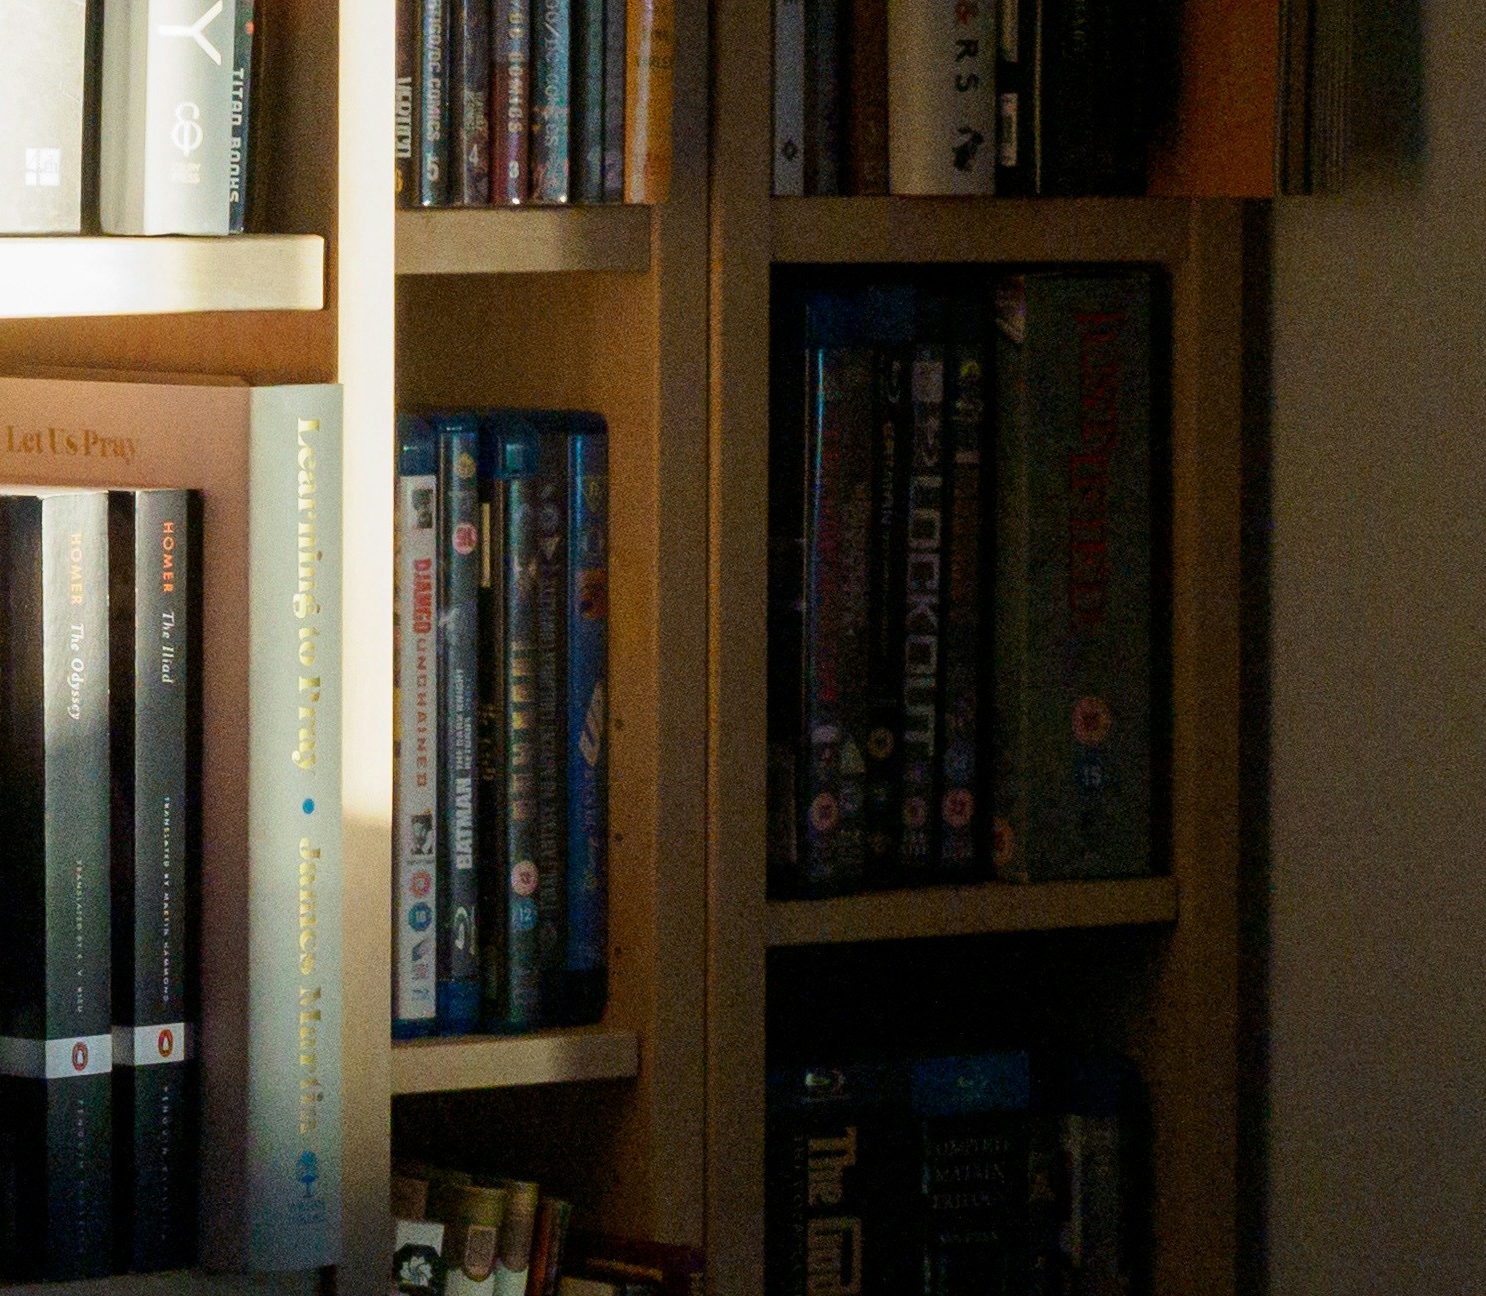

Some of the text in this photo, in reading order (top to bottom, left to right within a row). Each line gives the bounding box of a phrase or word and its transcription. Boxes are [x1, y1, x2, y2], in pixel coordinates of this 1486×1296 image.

[426, 77, 441, 141] COMICS
[65, 531, 86, 721] HOMER The Odyssey
[158, 520, 177, 685] HOMER The Iliad
[413, 557, 432, 788] DJANGO UNCHAINED
[902, 475, 943, 757] LOCKOUT
[456, 777, 474, 871] BATMAN
[807, 1125, 859, 1203] The
